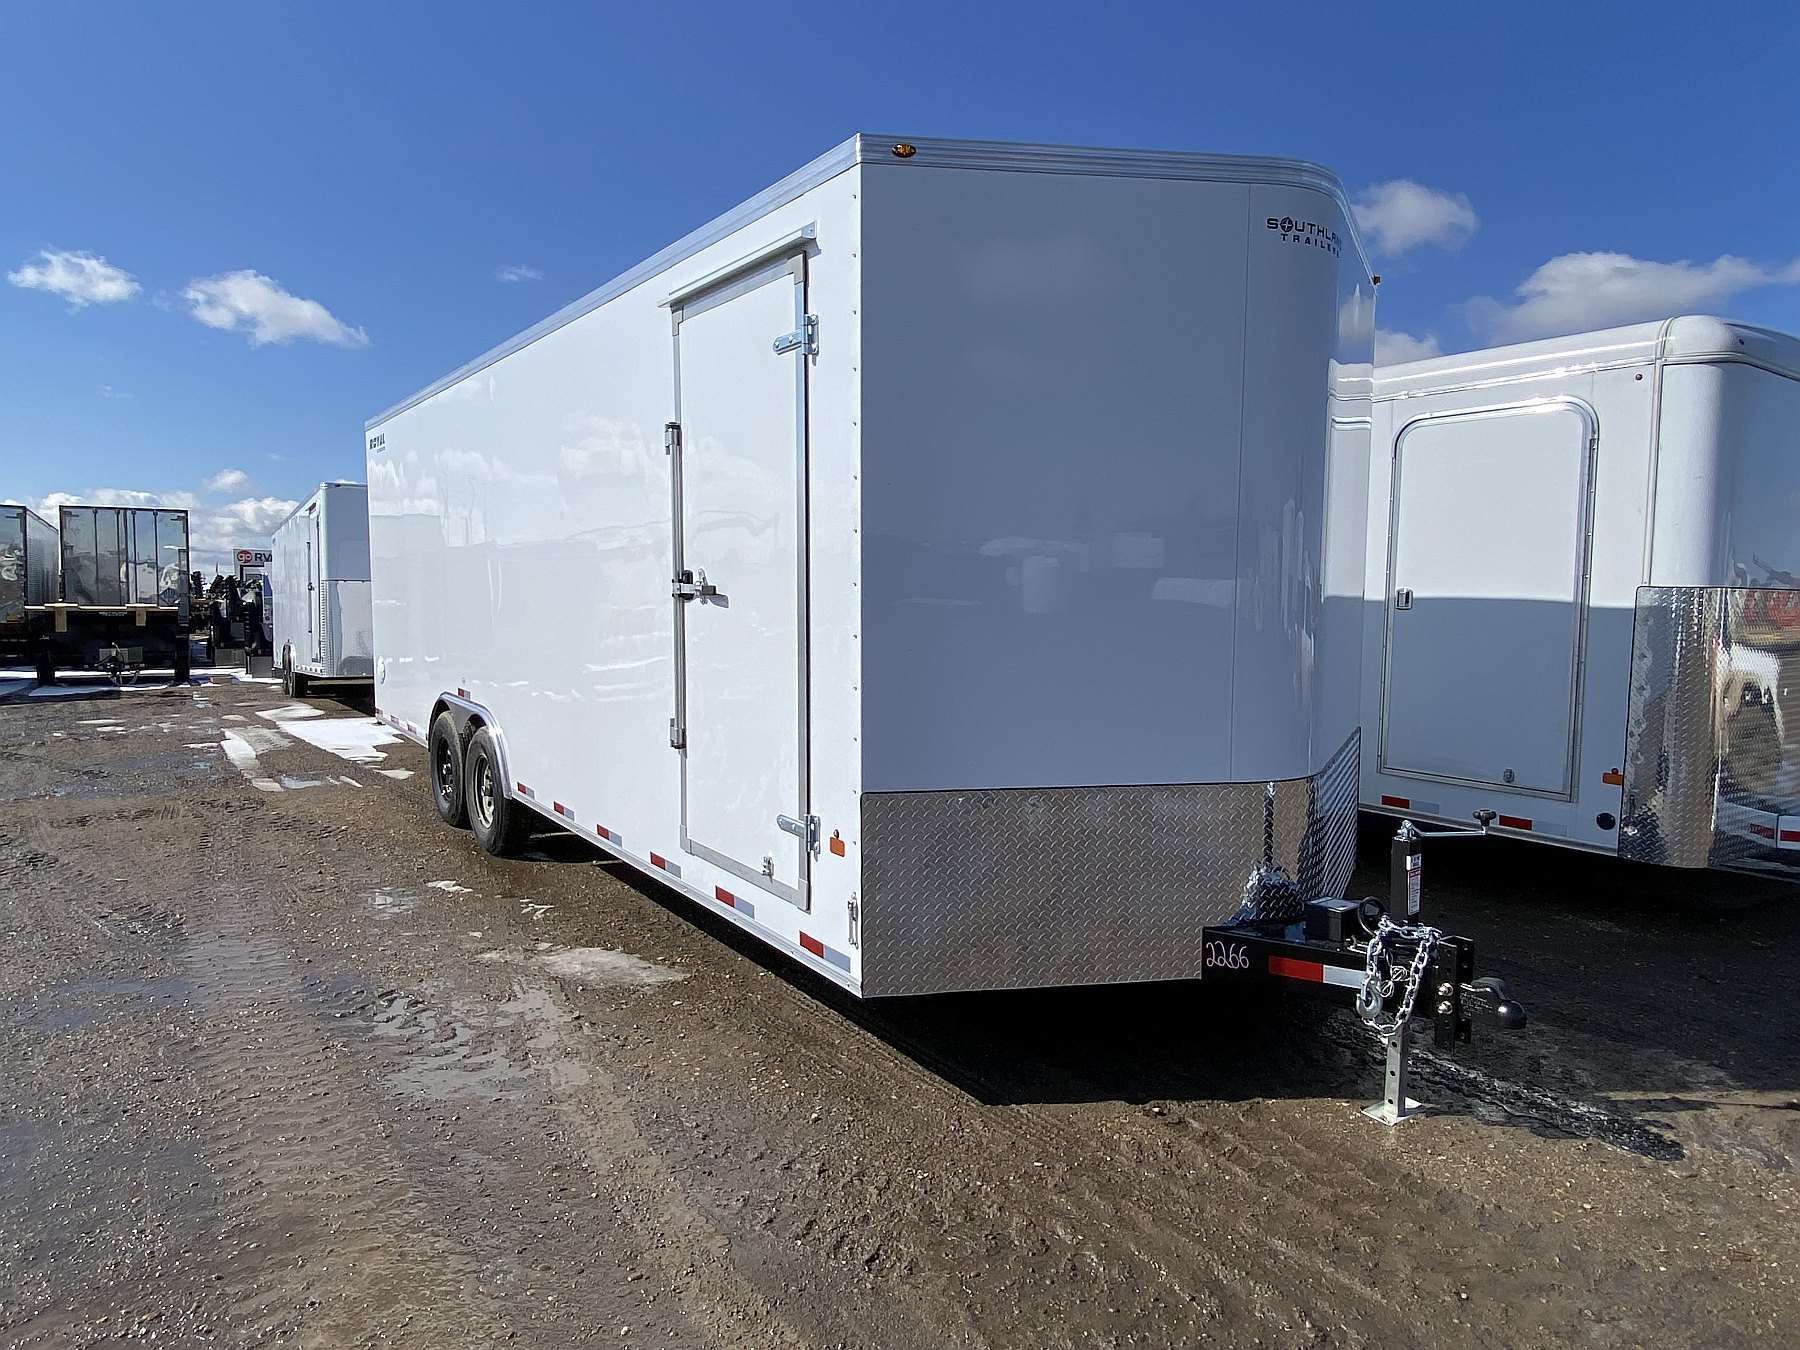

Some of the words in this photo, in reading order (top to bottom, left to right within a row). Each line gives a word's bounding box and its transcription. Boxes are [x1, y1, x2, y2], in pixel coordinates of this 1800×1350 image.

[1266, 216, 1341, 250] SOUTHLA
[254, 552, 272, 562] RV
[1206, 940, 1249, 969] 2266
